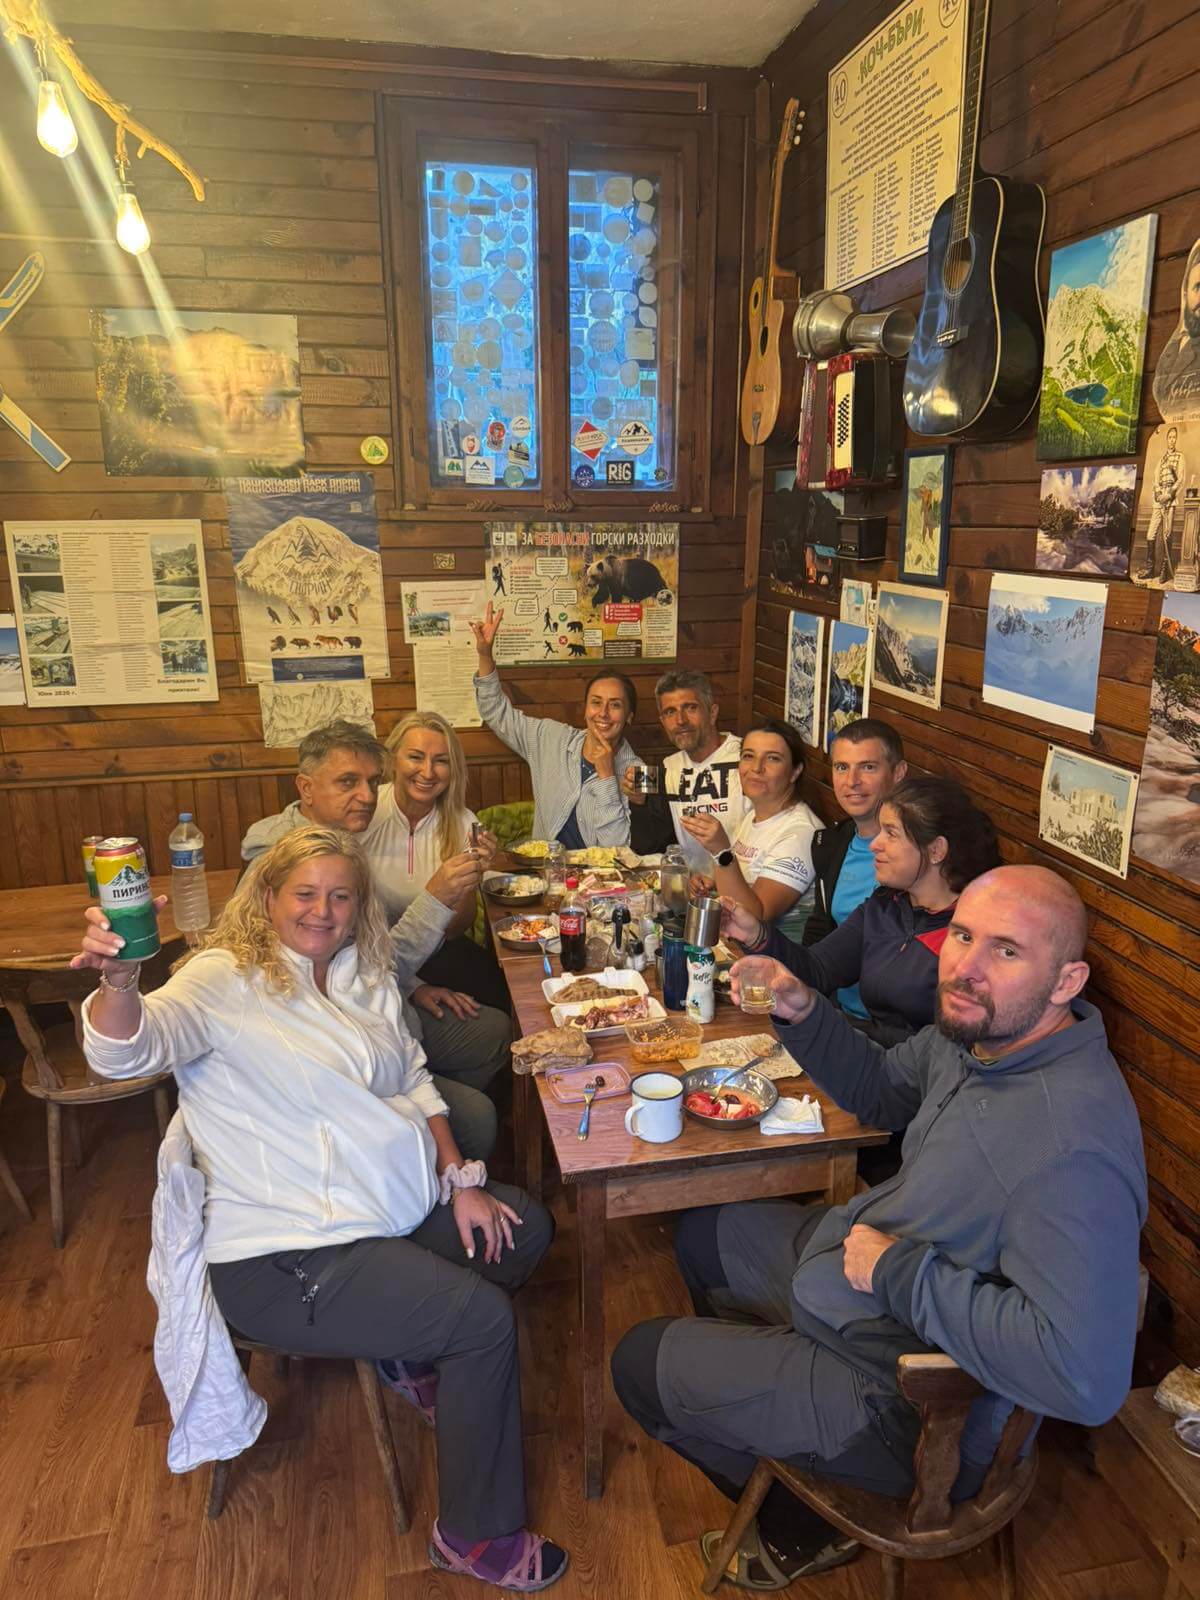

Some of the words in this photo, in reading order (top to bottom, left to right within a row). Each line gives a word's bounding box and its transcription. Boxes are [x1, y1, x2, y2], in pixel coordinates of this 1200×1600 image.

[608, 463, 632, 481] RIG
[521, 532, 534, 546] ЗА
[591, 532, 625, 546] ГОРСКИ
[627, 532, 675, 546] РАЗХОДКИ
